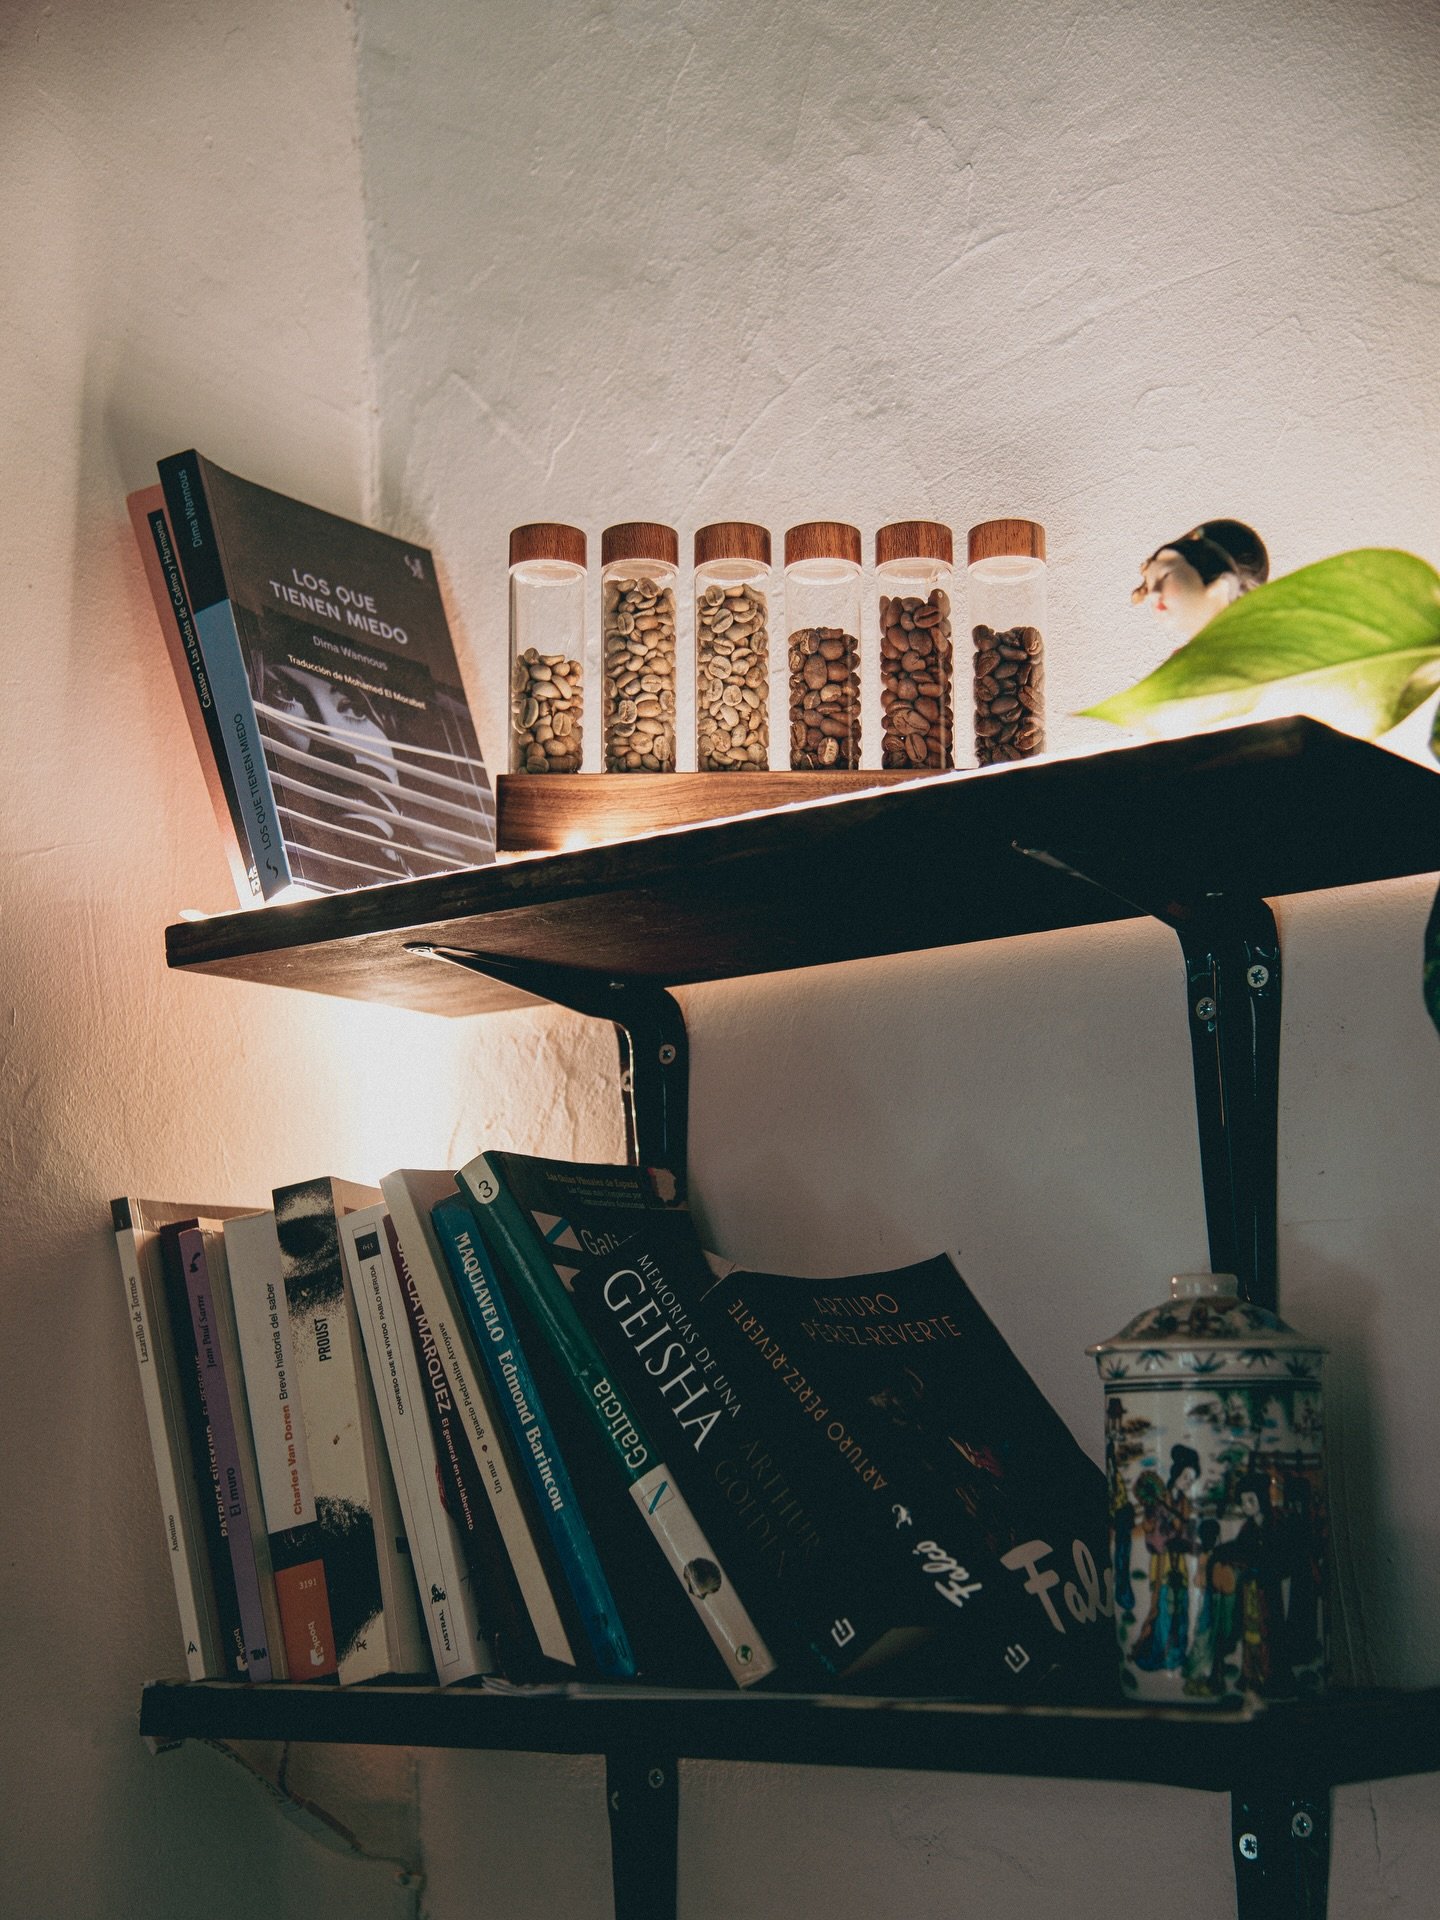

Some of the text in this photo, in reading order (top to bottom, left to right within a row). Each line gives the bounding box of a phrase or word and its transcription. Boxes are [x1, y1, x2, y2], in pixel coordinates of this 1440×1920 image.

[191, 519, 203, 548] Dima
[170, 572, 184, 606] Cadmo
[292, 568, 377, 614] LOS QUE
[179, 607, 187, 618] de
[269, 580, 408, 645] TIENEN MIEDO
[183, 619, 196, 648] bodas
[190, 649, 201, 666] Las
[312, 635, 388, 671] Dima Wannous
[197, 672, 211, 709] Calasso
[333, 671, 344, 680] de
[234, 713, 272, 850] LOS QUE TIENEN MIEDO
[478, 1180, 494, 1199] 3
[129, 1277, 141, 1310] Tormes
[369, 1264, 380, 1296] NERUDA
[375, 1295, 386, 1321] PABLO
[812, 1293, 899, 1316] ARTURO
[134, 1325, 149, 1364] Lazarillo
[314, 1318, 332, 1362] PROUST
[381, 1322, 391, 1350] VIVIDO
[637, 1254, 742, 1418] MEMORIAS DE UNA
[800, 1315, 962, 1346] PÉREZ-REVERTE
[388, 1362, 397, 1376] QUE
[455, 1231, 565, 1512] MAQUIAVELO Edmond Barincou
[603, 1269, 723, 1453] GEISHA
[266, 1283, 301, 1515] Charles Van Doren Breve historia del saber
[391, 1376, 404, 1415] CONFIESO
[727, 1299, 889, 1491] ARTURO PÉREZ-REVERTE
[465, 1408, 485, 1440] Ignacio
[593, 1377, 648, 1469] Galicia
[442, 1426, 458, 1462] general
[458, 1486, 474, 1531] laberinto
[487, 1459, 499, 1478] mar
[226, 1467, 242, 1518] El muro
[490, 1478, 503, 1495] Un
[167, 1514, 180, 1552] Anónimo
[299, 1578, 318, 1591] 3191
[439, 1609, 451, 1652] AUSTRAL
